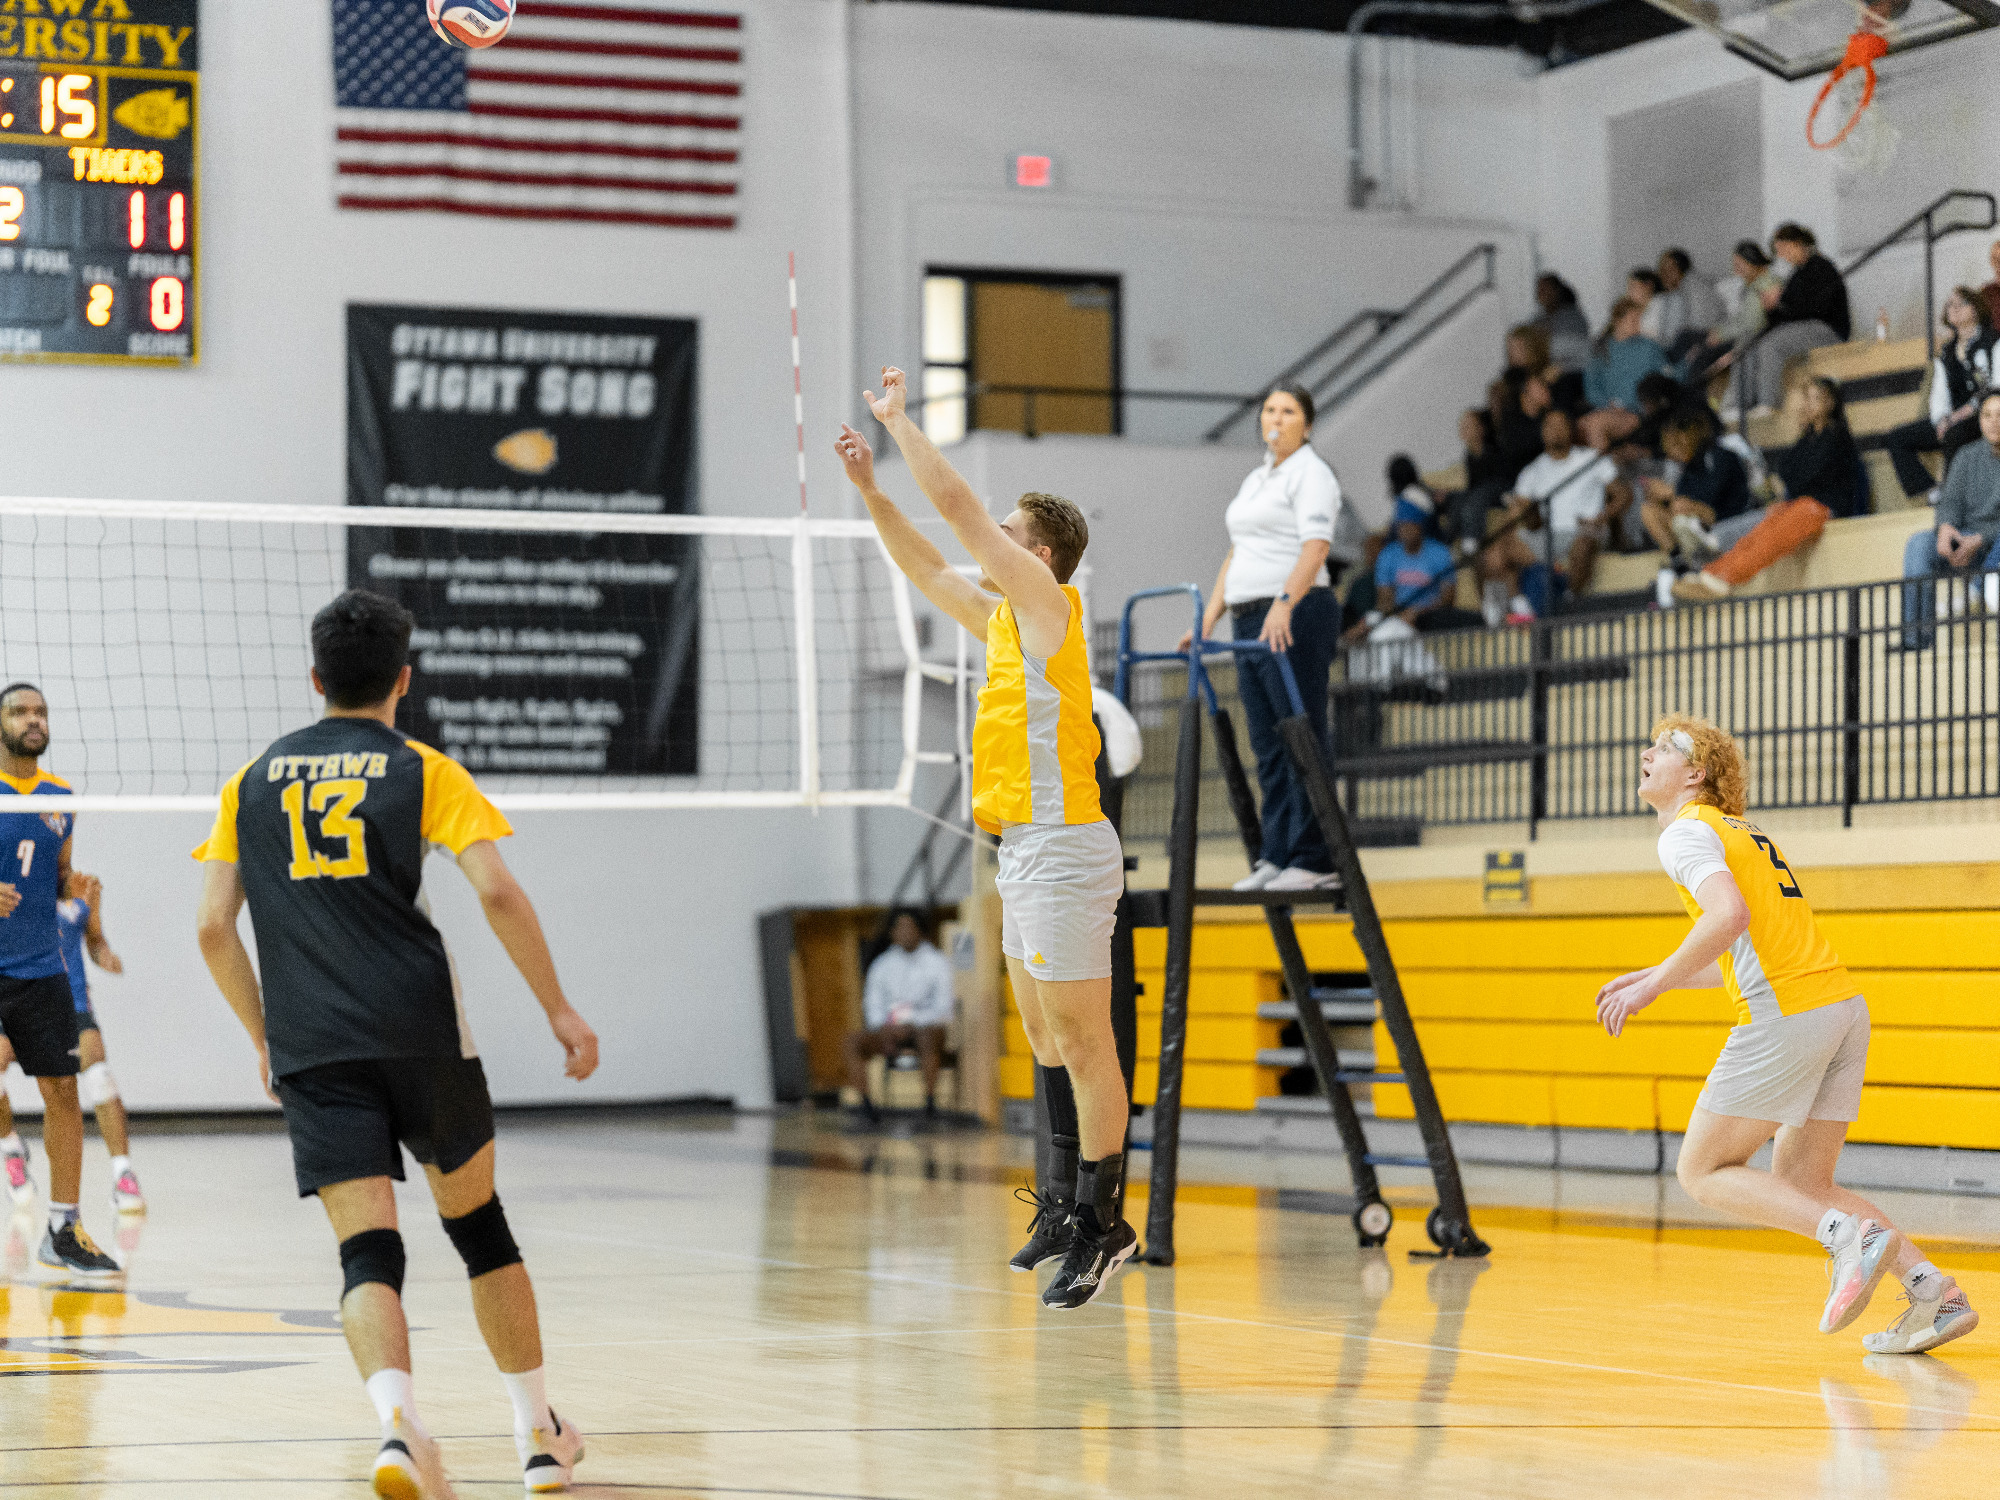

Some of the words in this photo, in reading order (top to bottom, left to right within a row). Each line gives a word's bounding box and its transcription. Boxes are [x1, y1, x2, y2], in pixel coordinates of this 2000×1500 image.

[68, 146, 164, 185] TIGERS
[128, 189, 186, 251] 11
[151, 276, 184, 331] 0
[501, 328, 657, 365] UNIVERSITY
[392, 358, 528, 413] FIGHT
[267, 752, 389, 782] OTTAWA
[281, 779, 370, 880] 13
